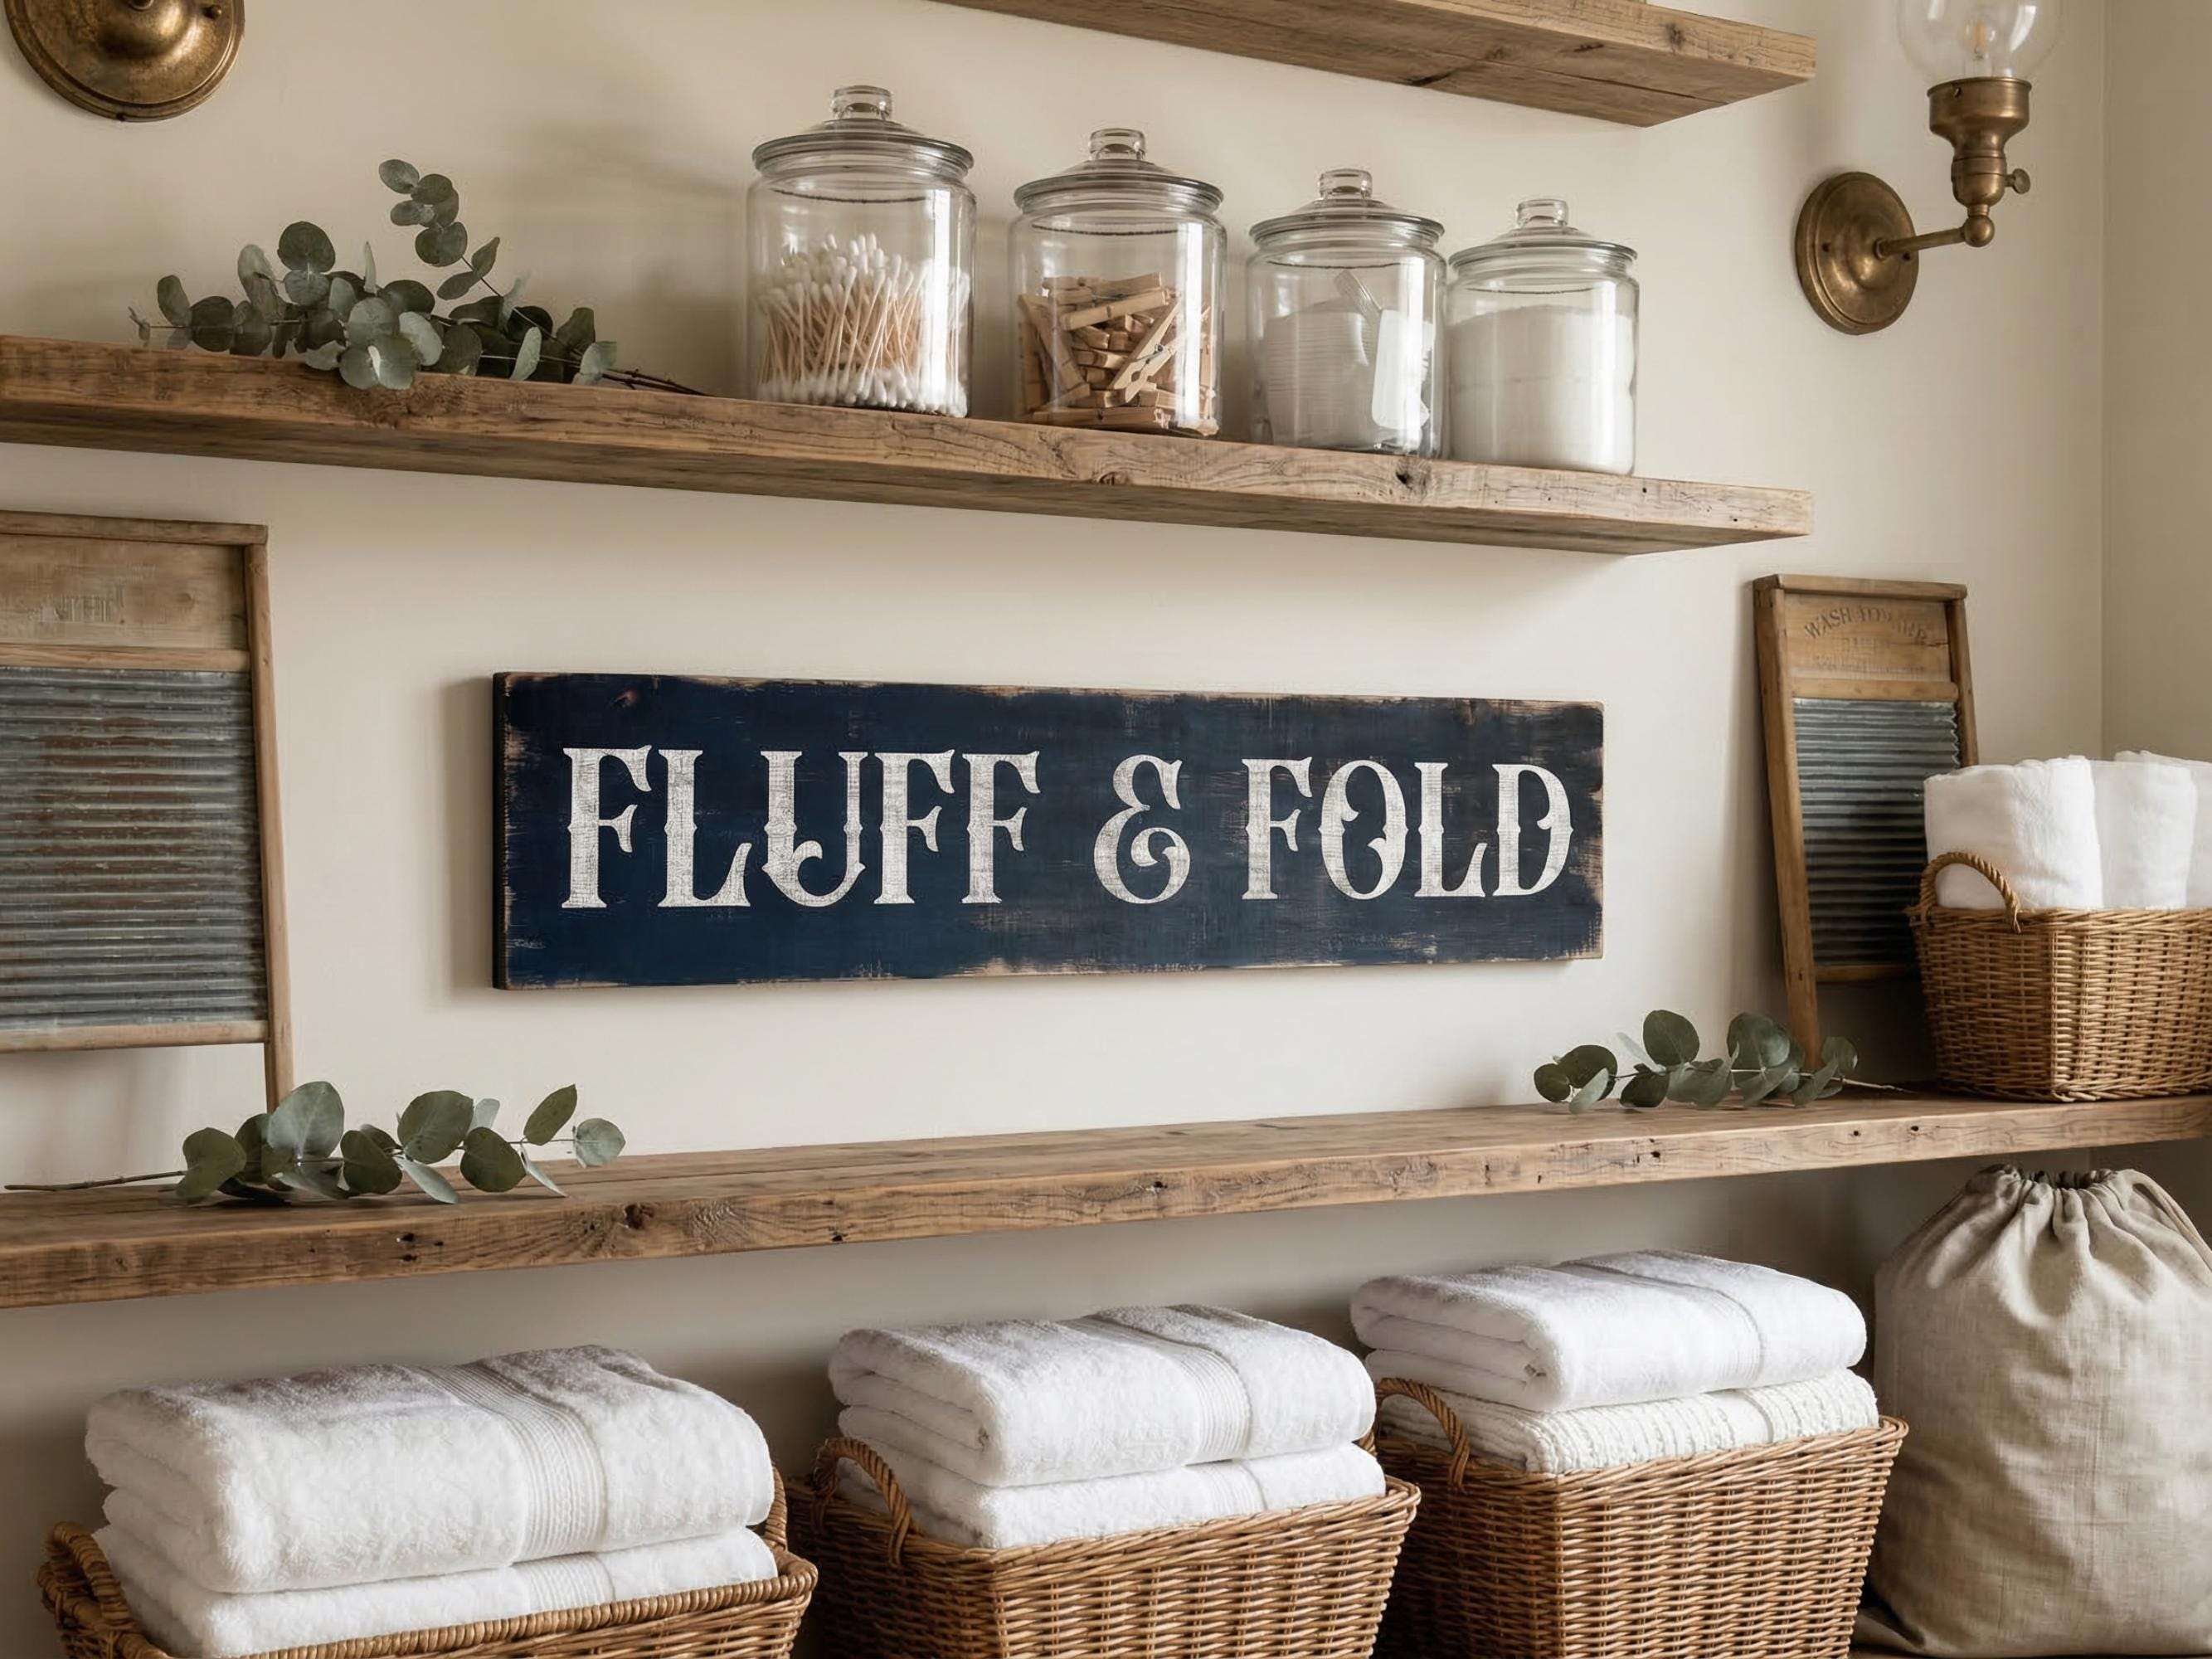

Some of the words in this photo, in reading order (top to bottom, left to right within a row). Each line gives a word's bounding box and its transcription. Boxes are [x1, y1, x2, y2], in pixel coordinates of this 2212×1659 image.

[1805, 606, 1851, 639] WASH
[562, 745, 1041, 908] FLUFF
[1093, 754, 1191, 904] &
[1242, 756, 1574, 900] FOLD
